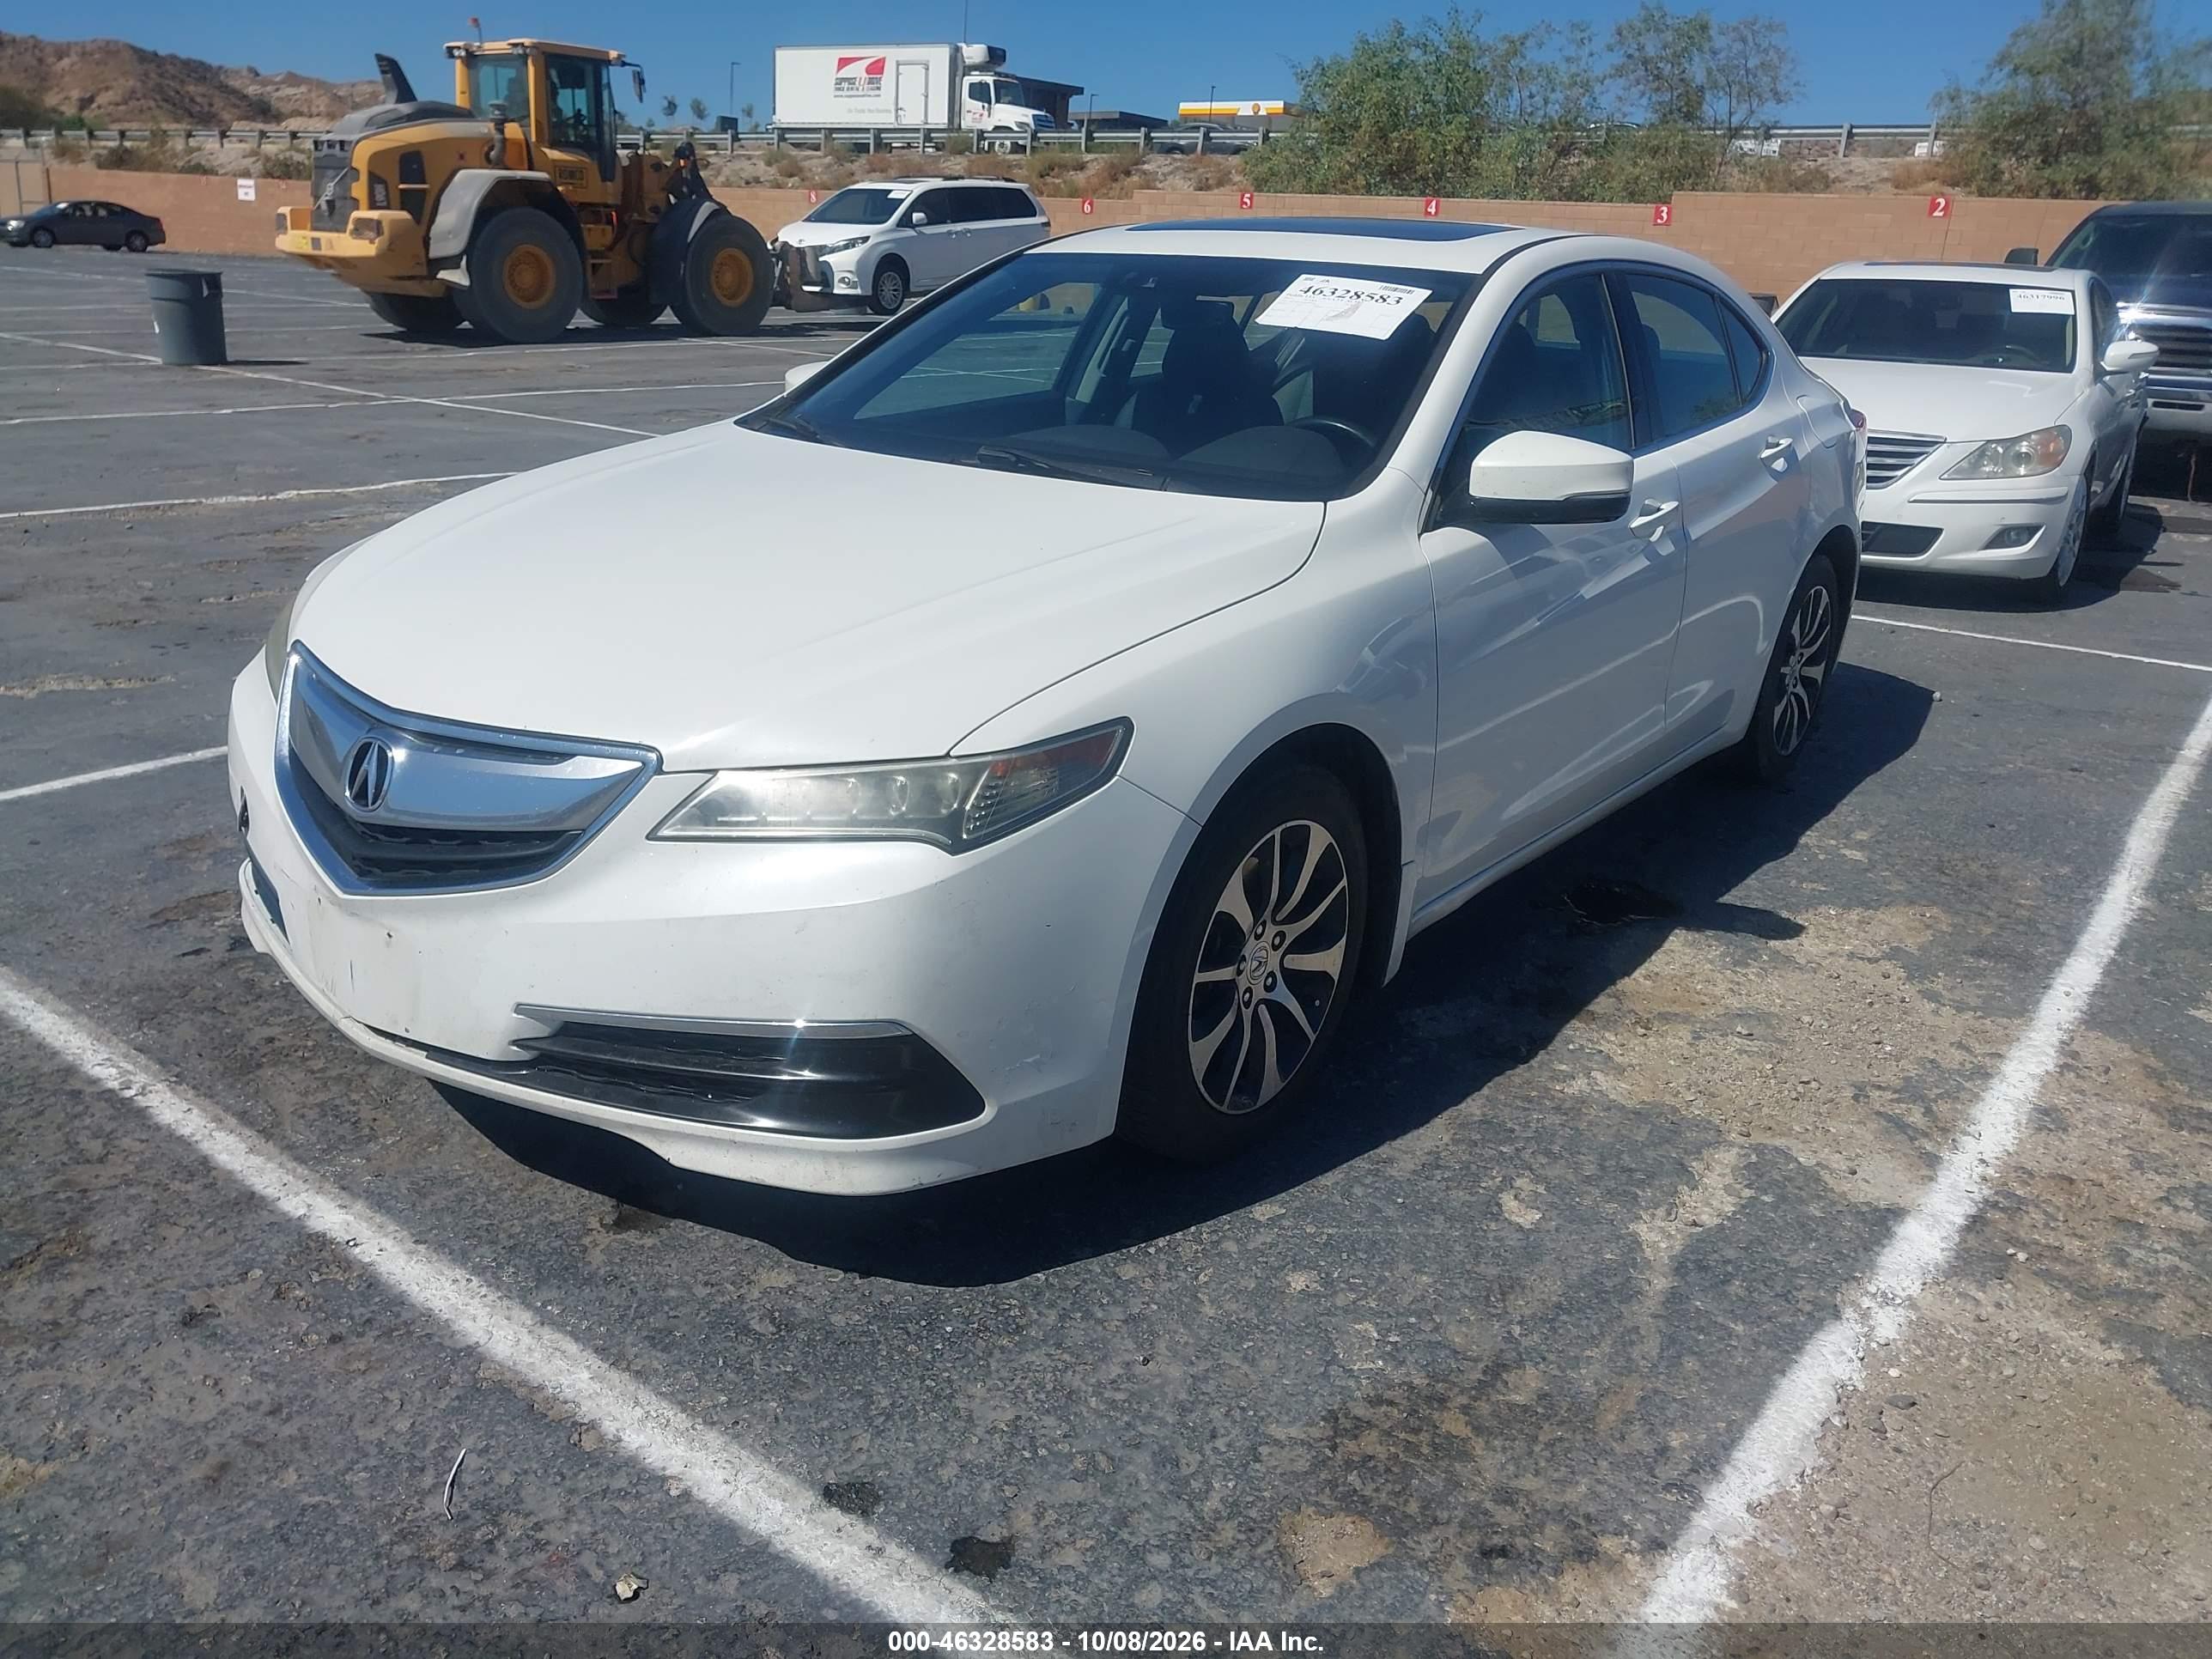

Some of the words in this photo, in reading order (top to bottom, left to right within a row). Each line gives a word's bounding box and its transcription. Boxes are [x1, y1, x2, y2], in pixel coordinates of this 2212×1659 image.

[810, 190, 817, 204] 8
[1084, 198, 1091, 214] 6
[1242, 193, 1251, 209] 5
[1426, 198, 1437, 216] 4
[1656, 205, 1668, 223] 3
[1931, 198, 1946, 216] 2
[1298, 285, 1404, 307] 46328583
